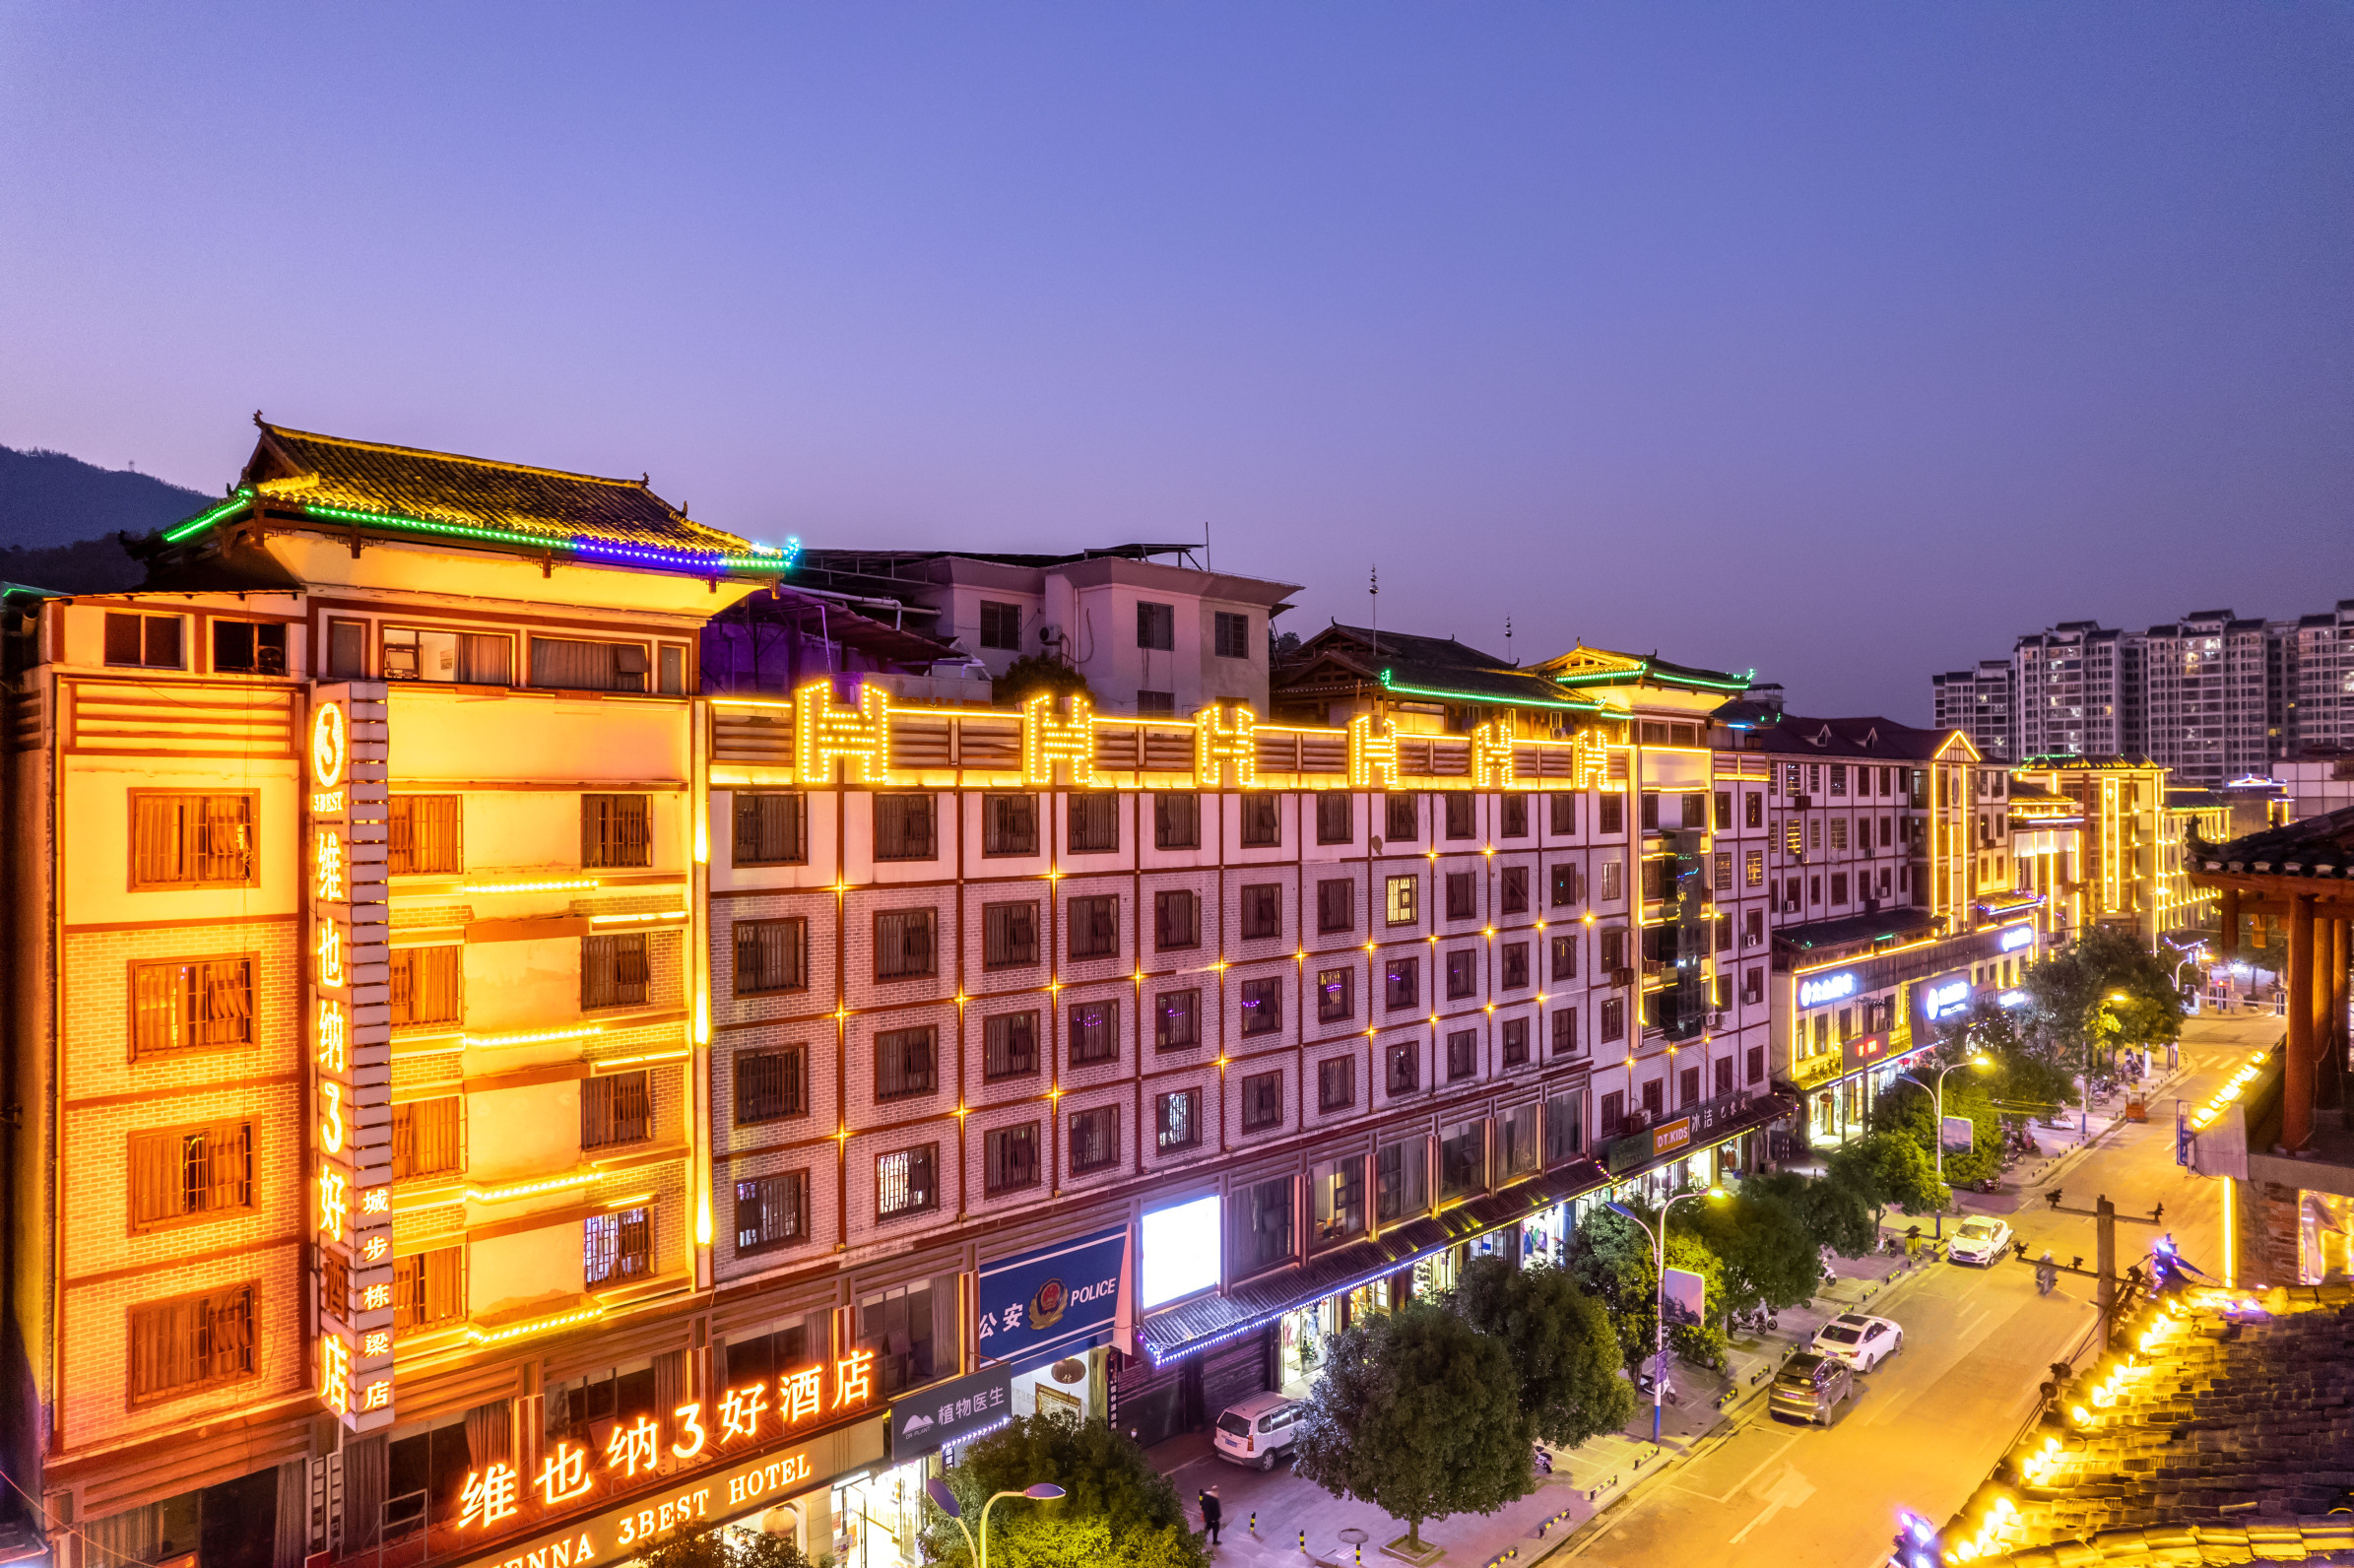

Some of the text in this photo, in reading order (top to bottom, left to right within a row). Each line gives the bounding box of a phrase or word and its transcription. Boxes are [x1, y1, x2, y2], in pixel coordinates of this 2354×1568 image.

[314, 791, 343, 812] 3BEST
[317, 831, 350, 1415] 维也纳3好酒店
[1657, 1126, 1688, 1148] DT.KIDS
[363, 1189, 390, 1409] 城步栋梁店
[979, 1277, 1116, 1339] 公安 POLICE
[458, 1350, 874, 1530] 维也纳3好酒店
[938, 1386, 1005, 1425] 植物医生
[490, 1455, 811, 1568] NNA 3BEST HOTEL
